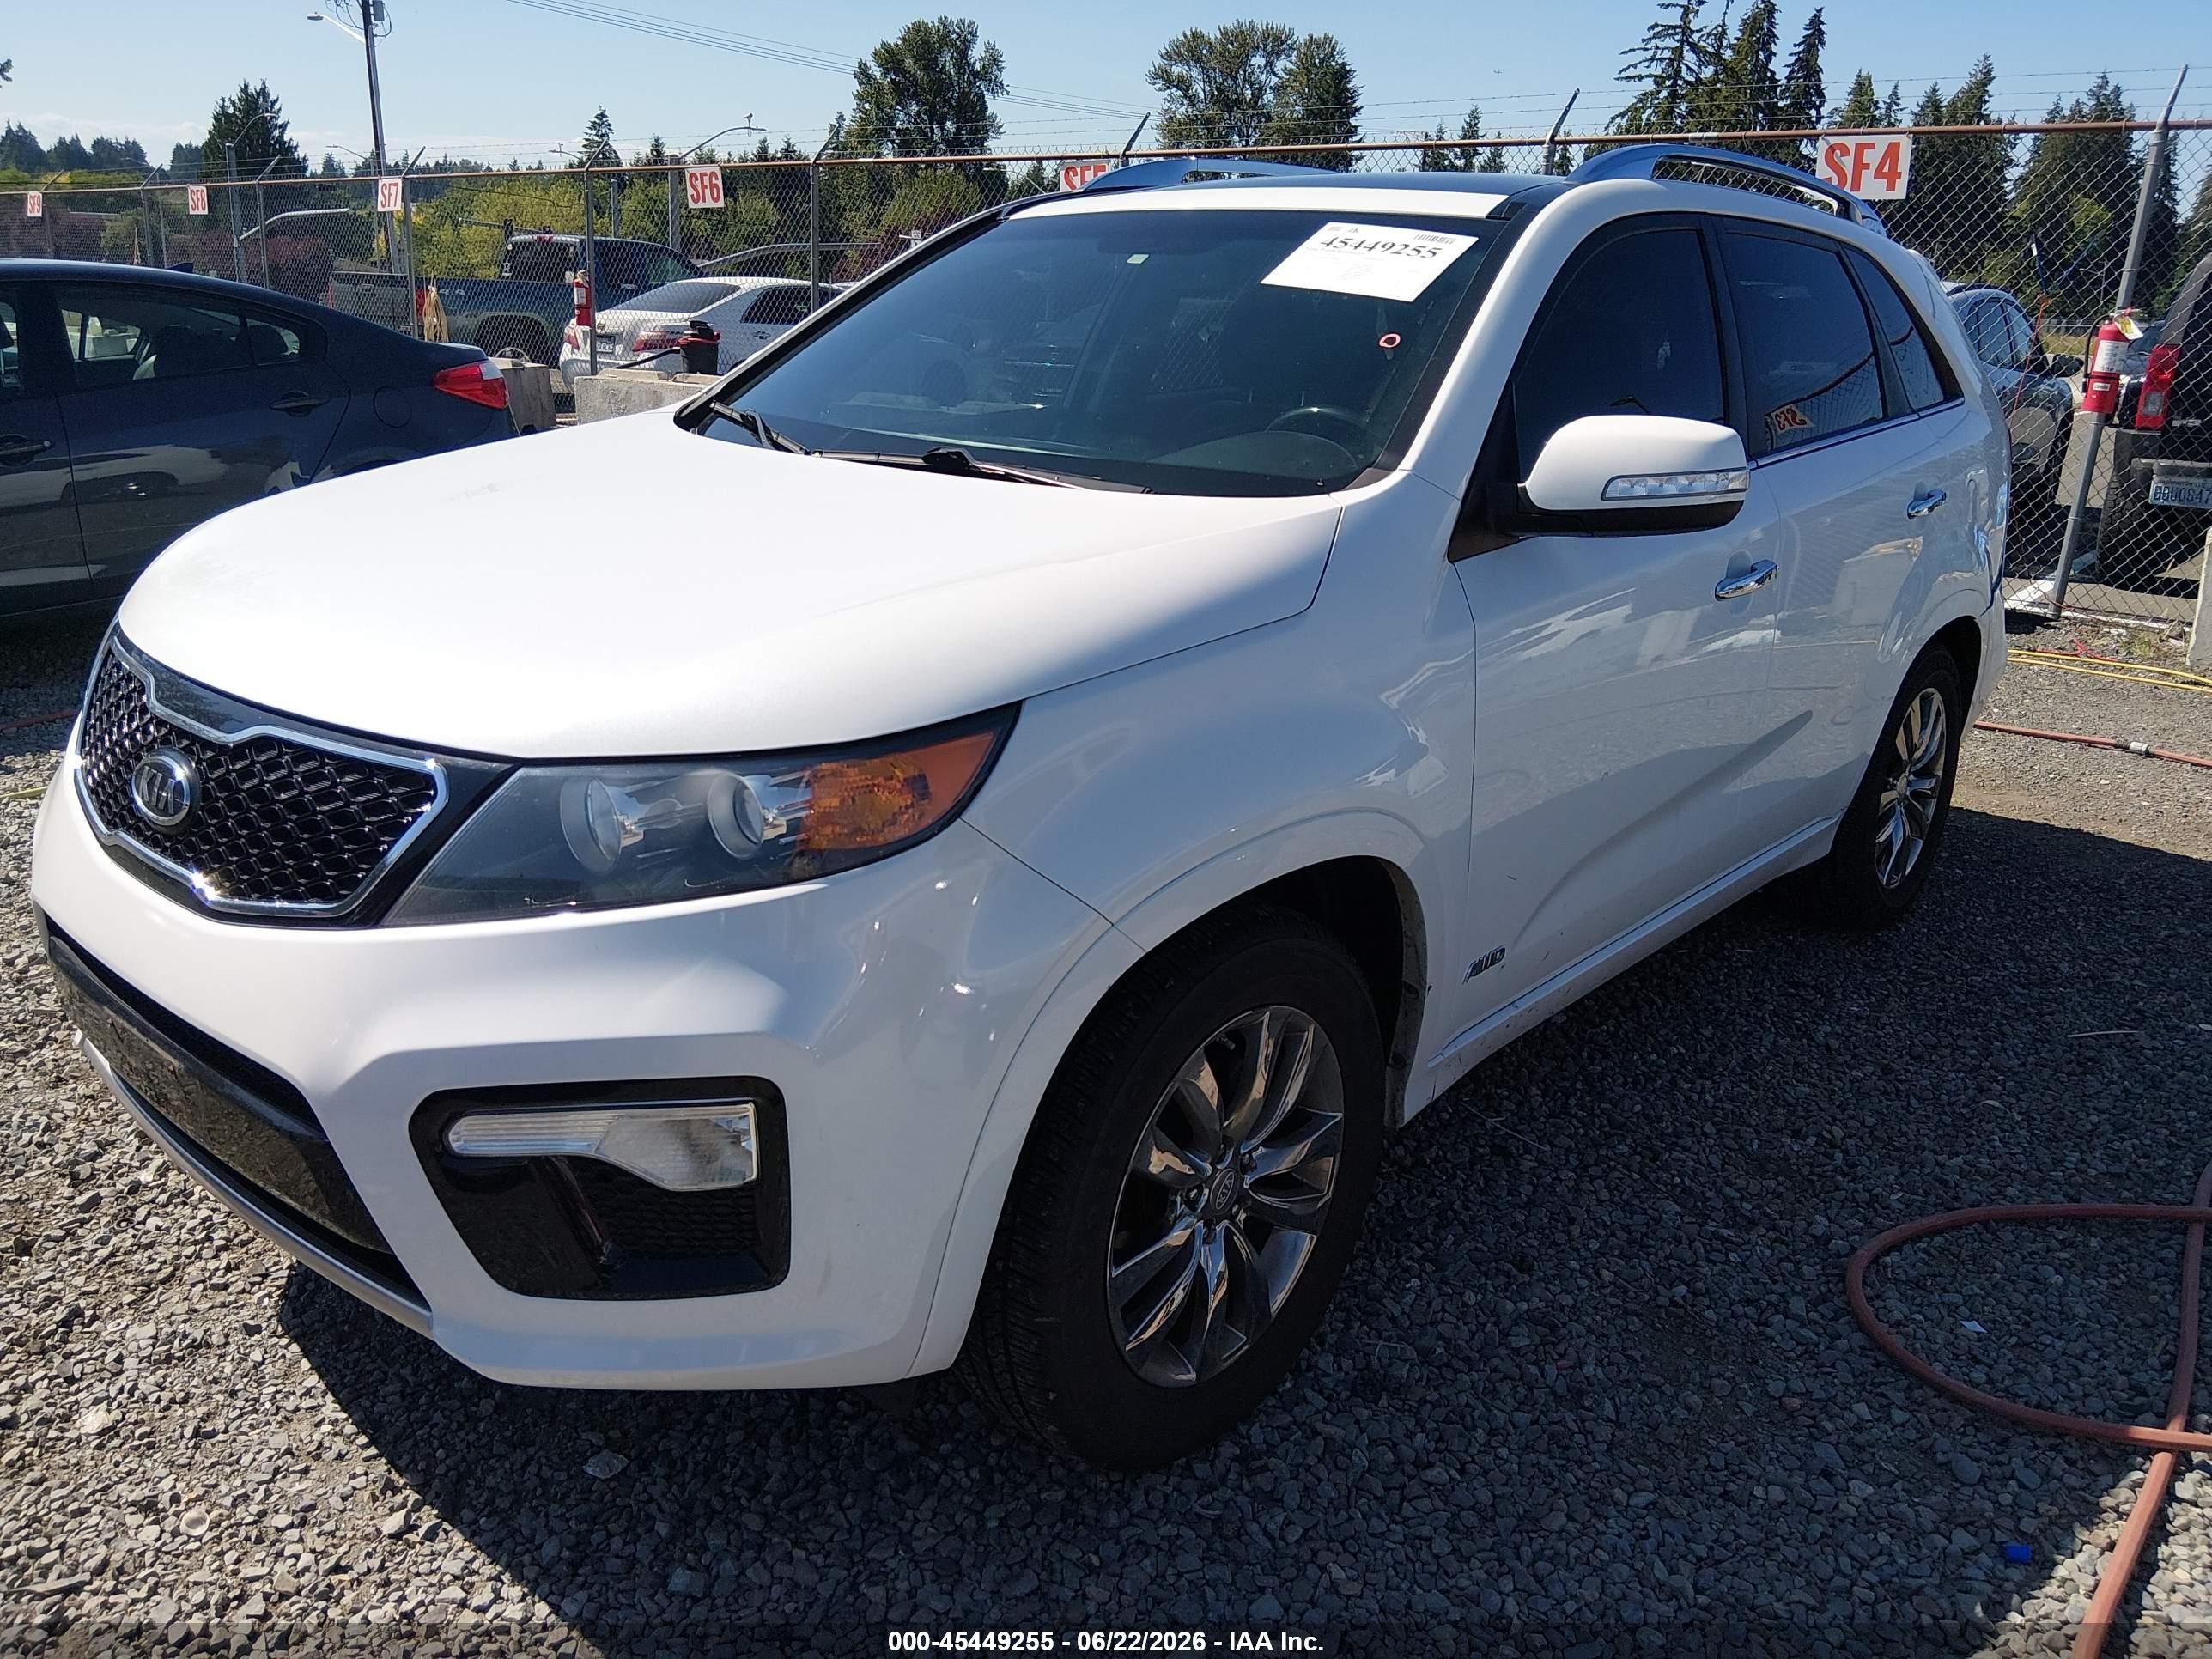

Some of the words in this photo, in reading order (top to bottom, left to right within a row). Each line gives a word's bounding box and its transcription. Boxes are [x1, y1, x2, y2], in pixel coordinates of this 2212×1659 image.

[1822, 142, 1902, 192] SF4
[190, 189, 206, 211] SF8
[380, 182, 399, 209] SF7
[688, 171, 721, 204] SF6
[28, 194, 41, 214] SF9
[1320, 236, 1443, 259] 45449255
